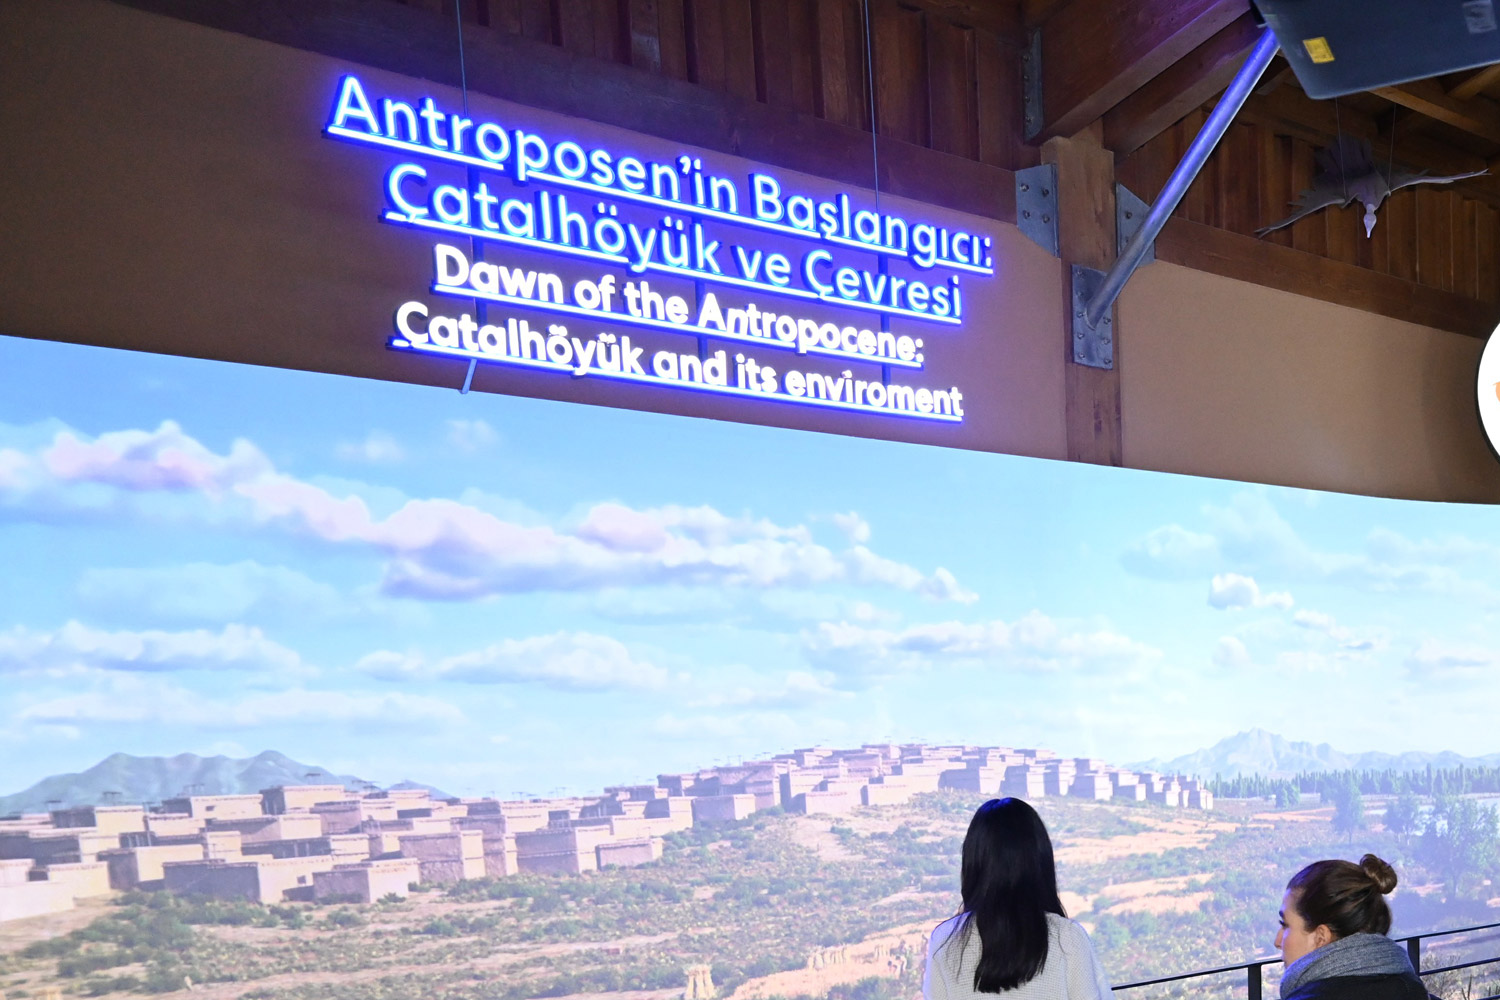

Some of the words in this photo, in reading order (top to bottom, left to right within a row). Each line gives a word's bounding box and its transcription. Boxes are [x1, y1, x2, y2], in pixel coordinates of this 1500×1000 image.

[751, 173, 992, 268] Başlangıcı:
[434, 243, 564, 304] Dawn
[573, 274, 616, 312] of
[623, 280, 689, 324] the
[697, 292, 925, 363] Antropocene:
[735, 245, 791, 287] ve
[804, 248, 962, 318] Çevresi
[653, 350, 728, 386] and
[735, 353, 778, 393] its
[785, 370, 964, 416] enviroment
